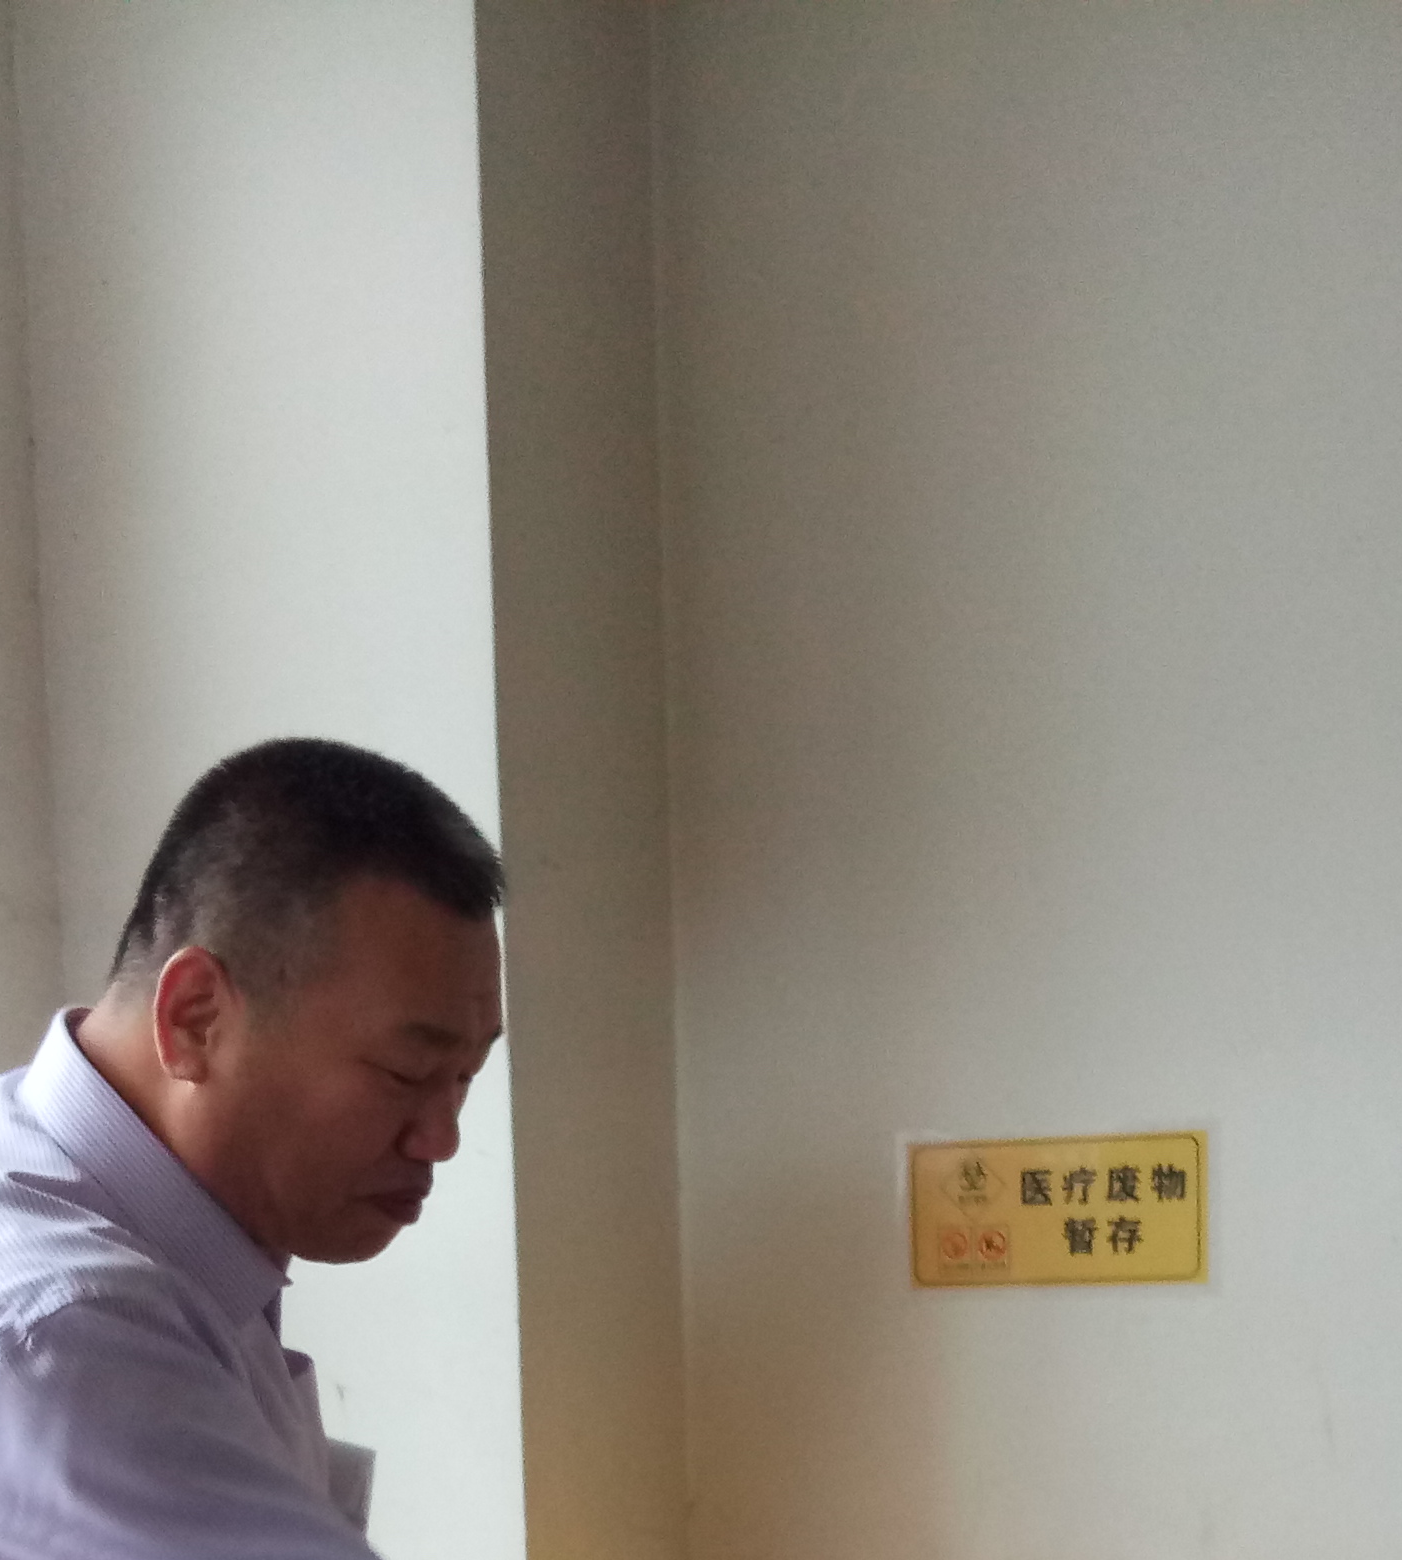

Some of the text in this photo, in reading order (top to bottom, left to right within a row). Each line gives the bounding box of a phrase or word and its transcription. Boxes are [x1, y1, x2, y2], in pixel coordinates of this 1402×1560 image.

[1020, 1162, 1188, 1206] 医疗废物
[1063, 1215, 1143, 1255] 暂存
